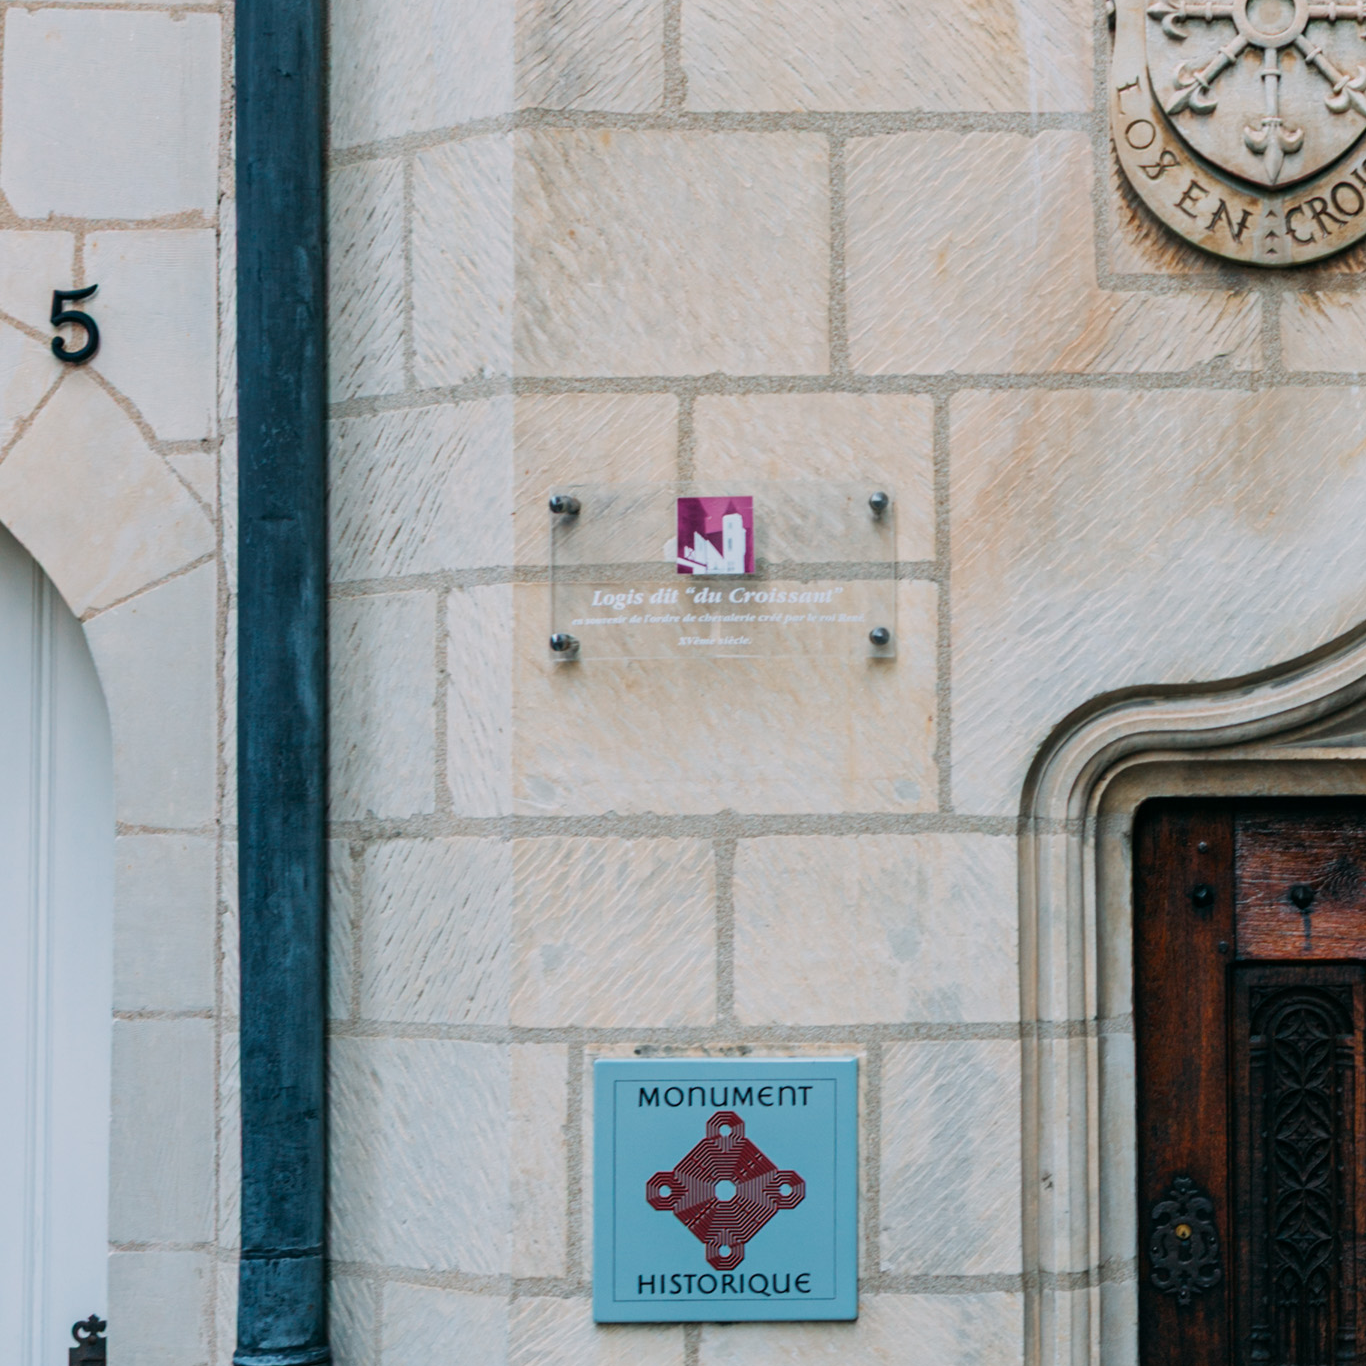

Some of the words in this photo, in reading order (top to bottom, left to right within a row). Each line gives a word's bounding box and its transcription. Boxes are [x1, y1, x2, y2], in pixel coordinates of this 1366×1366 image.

[1116, 75, 1182, 181] LOS
[1173, 179, 1254, 245] EN
[50, 283, 99, 365] 5
[591, 589, 645, 611] Logis
[649, 587, 679, 605] dit
[629, 614, 642, 624] de
[682, 613, 696, 623] de
[783, 614, 805, 626] par
[638, 1085, 813, 1107] MONUMENT
[637, 1272, 812, 1296] HISTORIQUE
